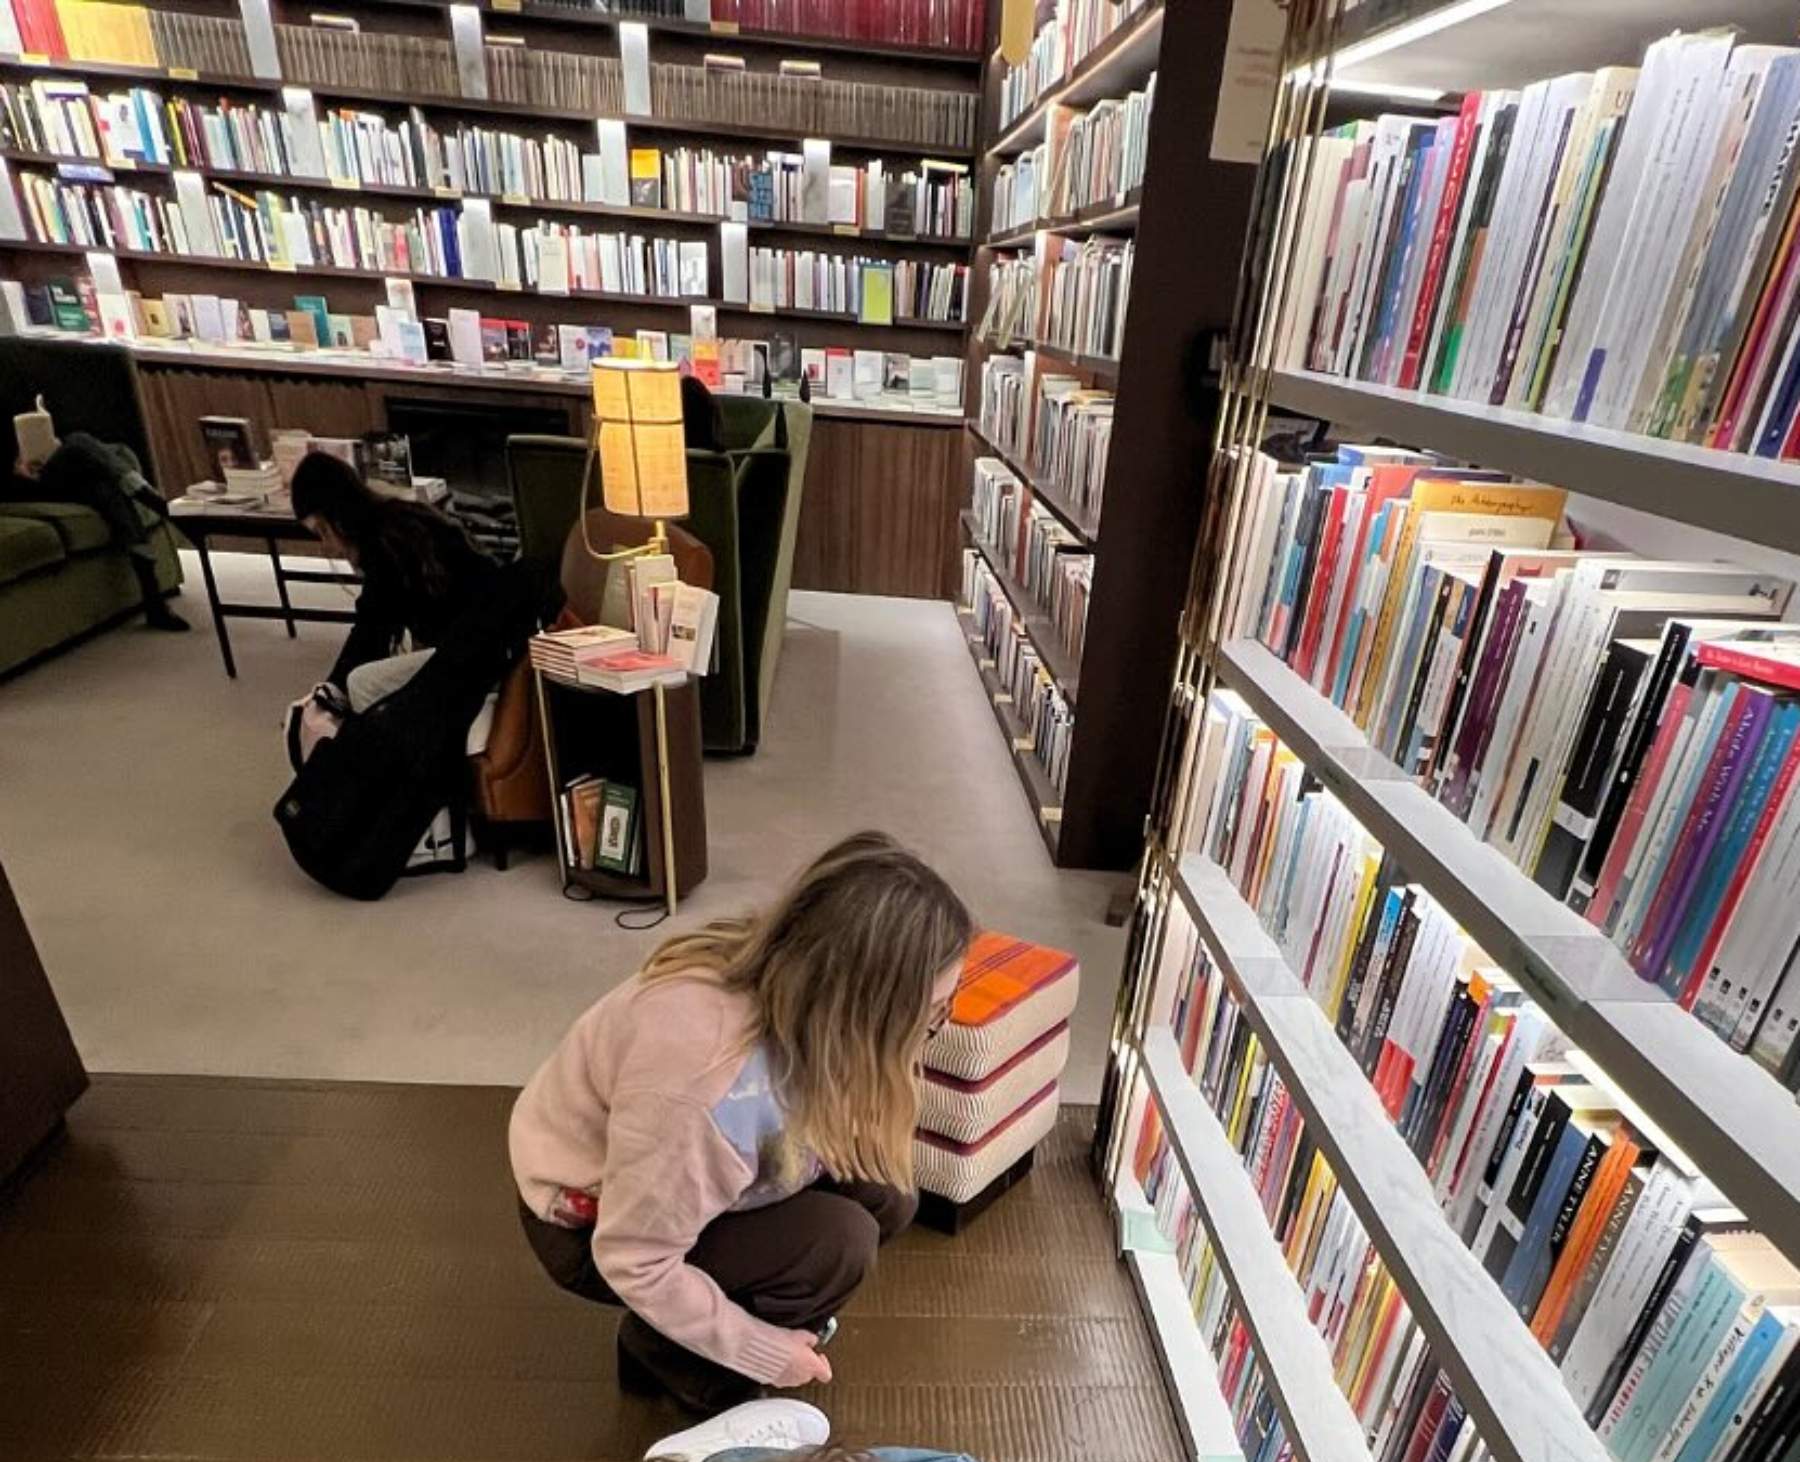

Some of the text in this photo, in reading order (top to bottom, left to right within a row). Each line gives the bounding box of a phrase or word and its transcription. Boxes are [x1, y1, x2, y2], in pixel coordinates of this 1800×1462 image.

[1709, 765, 1732, 802] With
[1697, 811, 1713, 832] Me
[1551, 1144, 1599, 1243] ANNE TYLER
[1586, 1182, 1634, 1282] ANNE TYLER
[1644, 1296, 1684, 1368] UPDIKE
